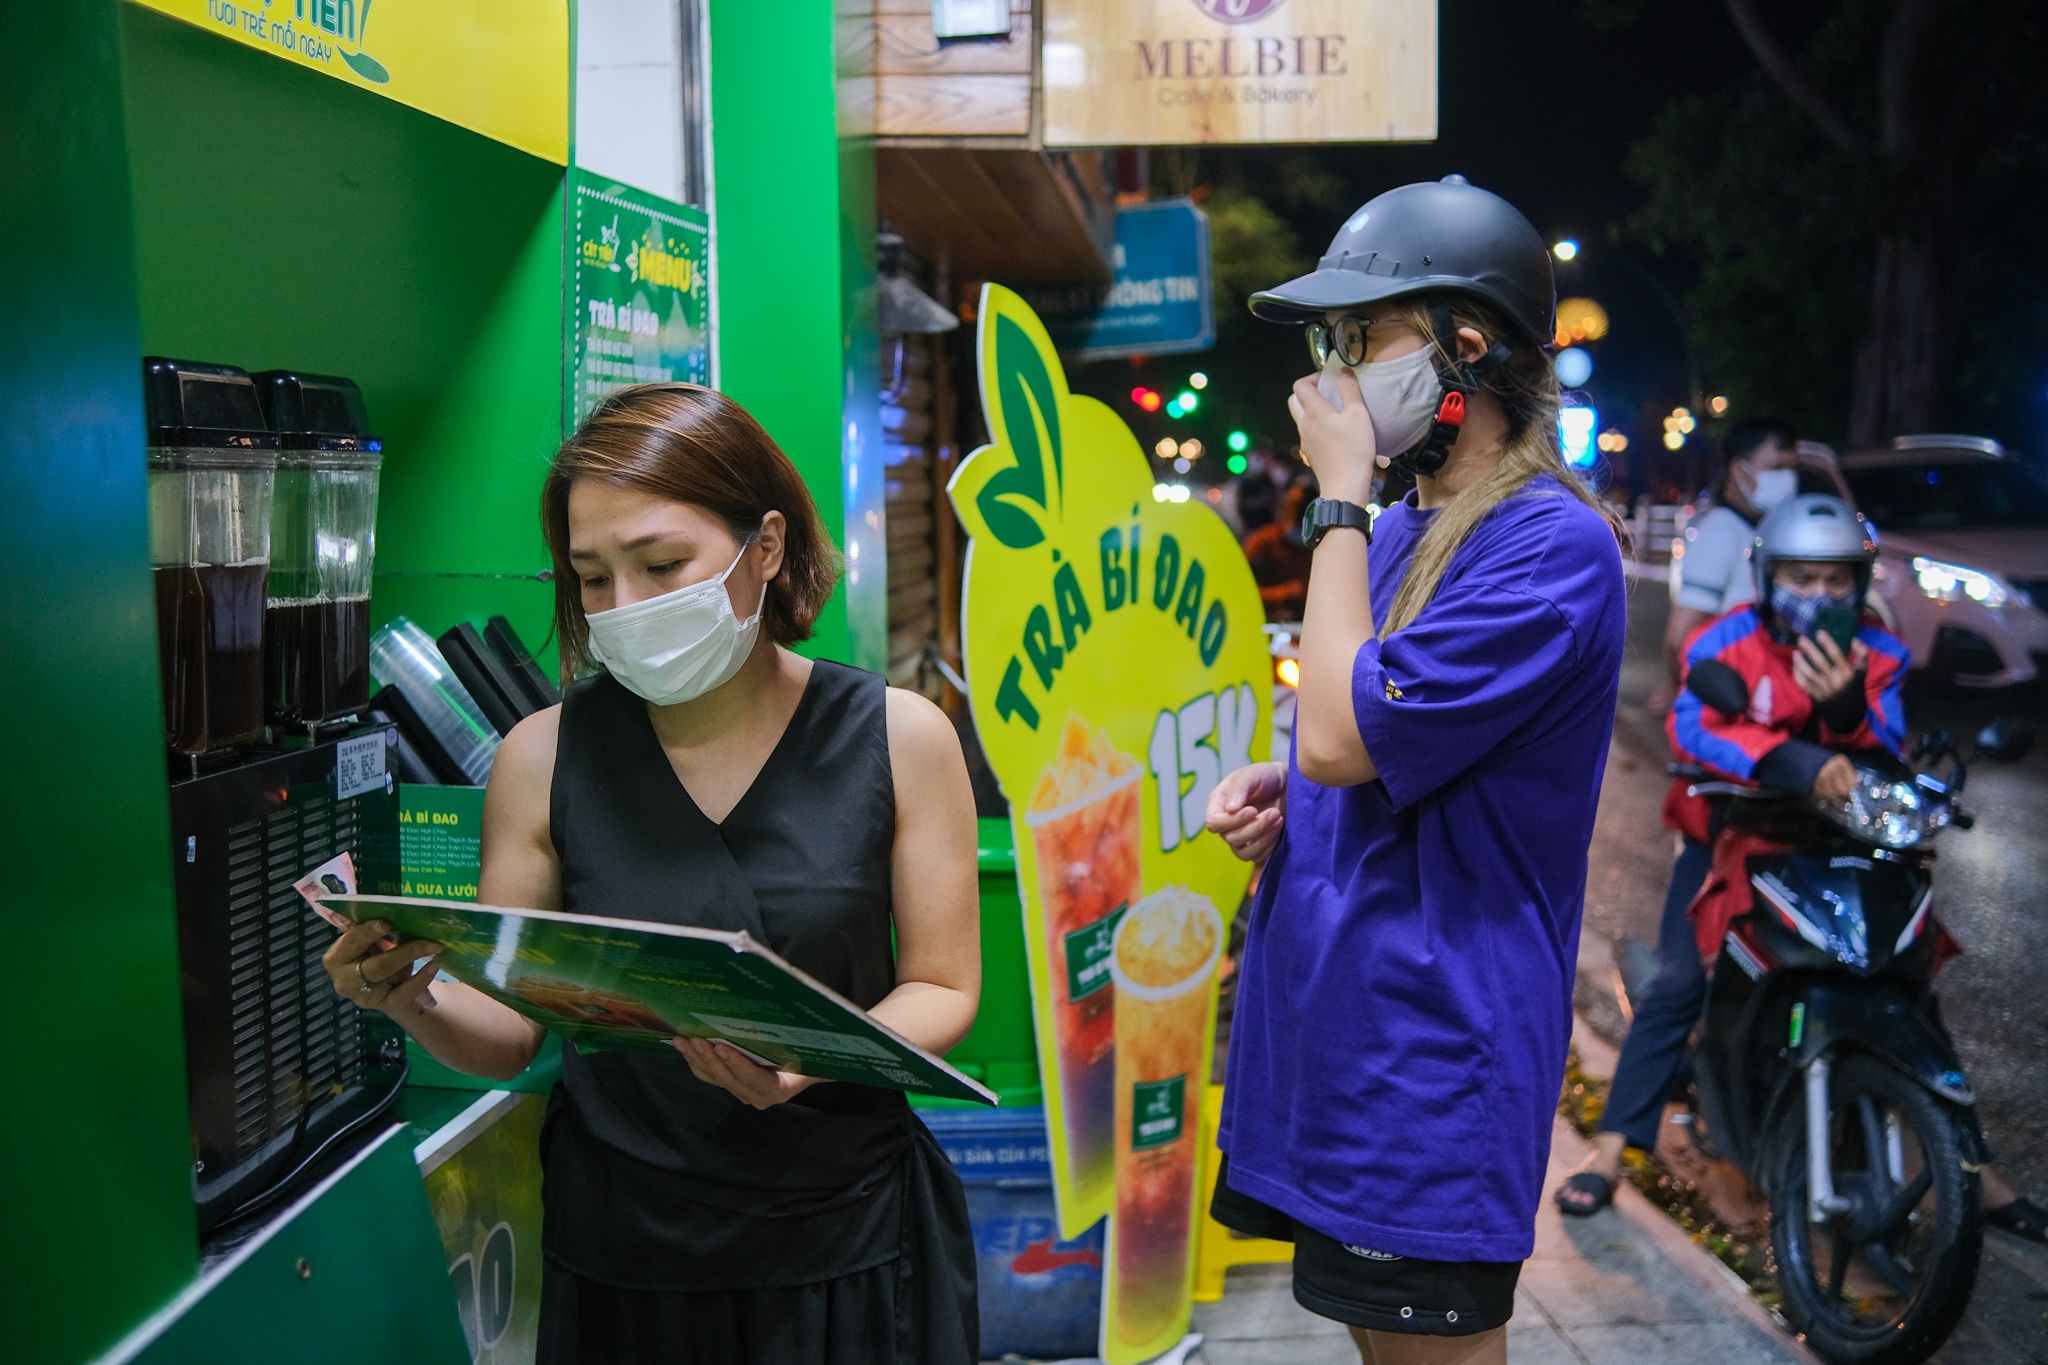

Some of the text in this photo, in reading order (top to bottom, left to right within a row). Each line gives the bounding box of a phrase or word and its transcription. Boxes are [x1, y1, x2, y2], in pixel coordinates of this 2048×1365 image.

[240, 10, 267, 39] TRẺ
[271, 20, 296, 50] MỖI
[300, 35, 332, 63] NGÀY
[1131, 34, 1349, 81] MELBIE
[1241, 84, 1319, 106] Bakery
[639, 246, 692, 293] MENU
[588, 297, 616, 330] TRÀ
[994, 548, 1092, 731] TRÀ
[1100, 501, 1142, 611] BÍ
[1148, 681, 1258, 853] 15K
[416, 809, 429, 824] BÍ
[447, 882, 478, 897] LƯỚI
